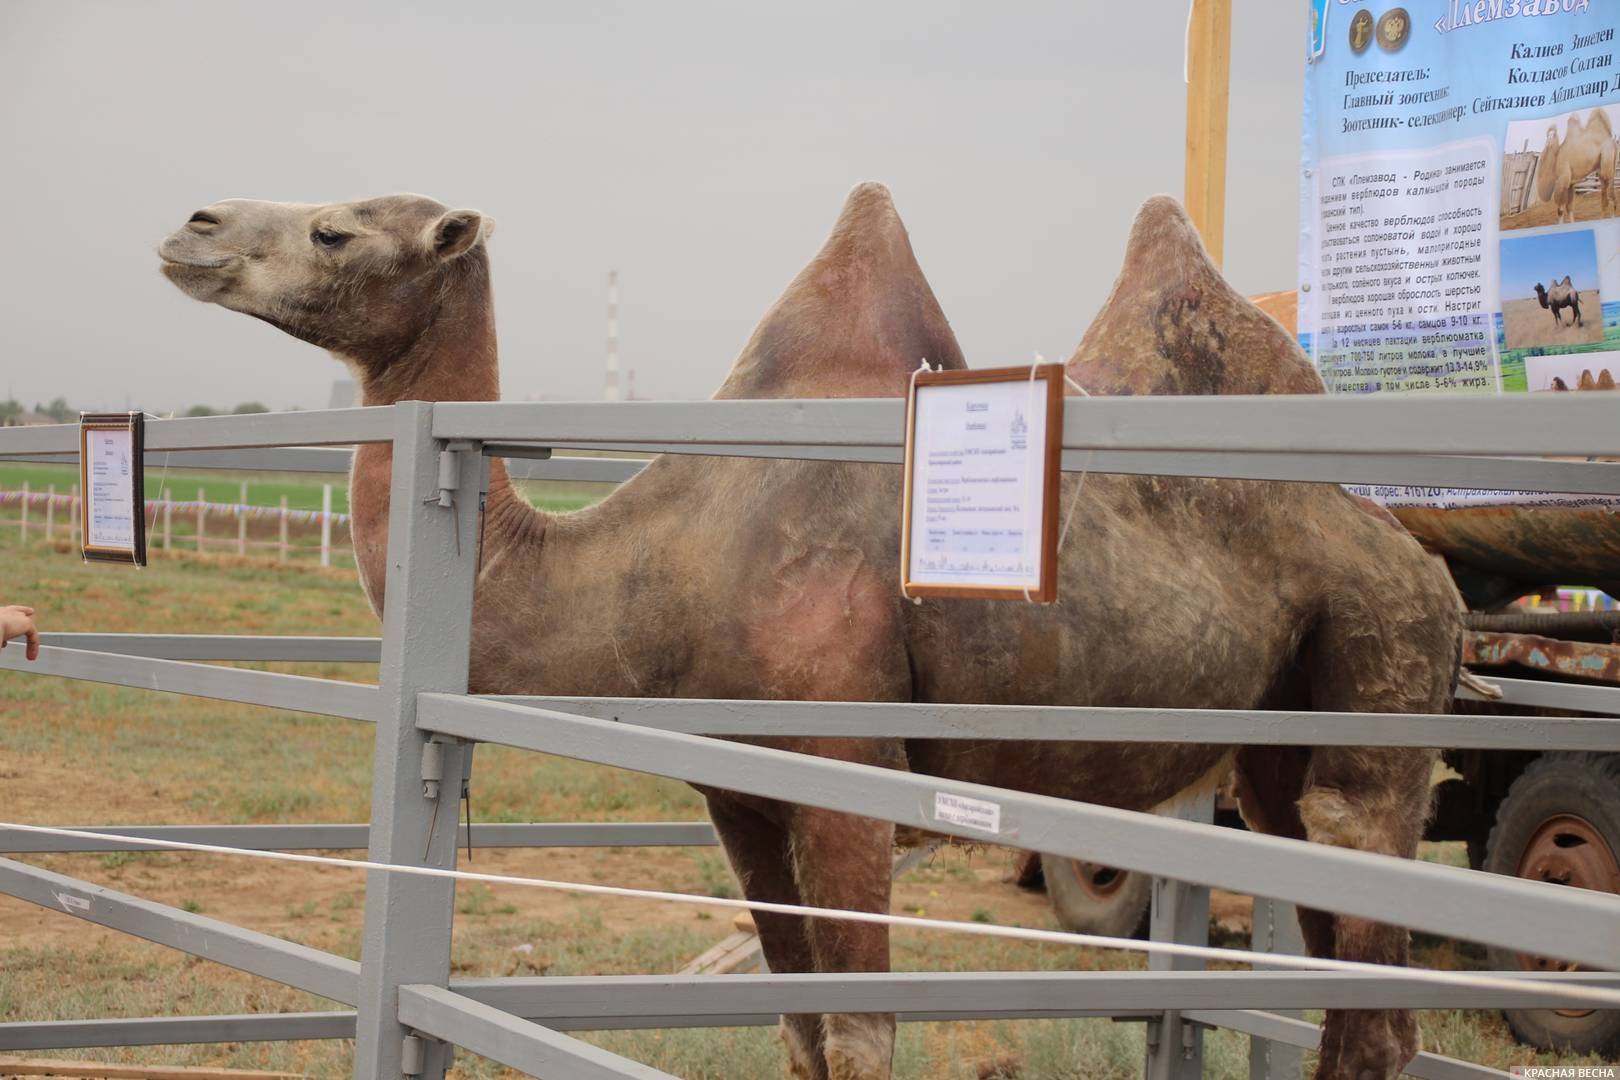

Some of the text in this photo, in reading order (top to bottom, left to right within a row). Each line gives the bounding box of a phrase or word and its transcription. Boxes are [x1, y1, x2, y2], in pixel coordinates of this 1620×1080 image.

[1511, 43, 1564, 59] Калиев
[1508, 54, 1612, 84] Колдасов Солтан
[1345, 68, 1430, 89] Председатель:
[1343, 90, 1394, 110] Главный
[1341, 117, 1403, 133] Зоотехник-
[1472, 94, 1545, 114] Сейтказиев
[1444, 160, 1486, 175] занимается
[1351, 187, 1399, 200] верблюдов
[1454, 177, 1485, 189] породы
[1384, 214, 1435, 227] верблюдов
[1453, 223, 1482, 236] хорошо
[1445, 285, 1481, 298] шерстью
[1445, 300, 1481, 313] Настриг
[1418, 319, 1447, 330] самцов
[1451, 315, 1468, 326] 9-10
[1342, 337, 1350, 348] 12
[1453, 347, 1486, 359] лучшие
